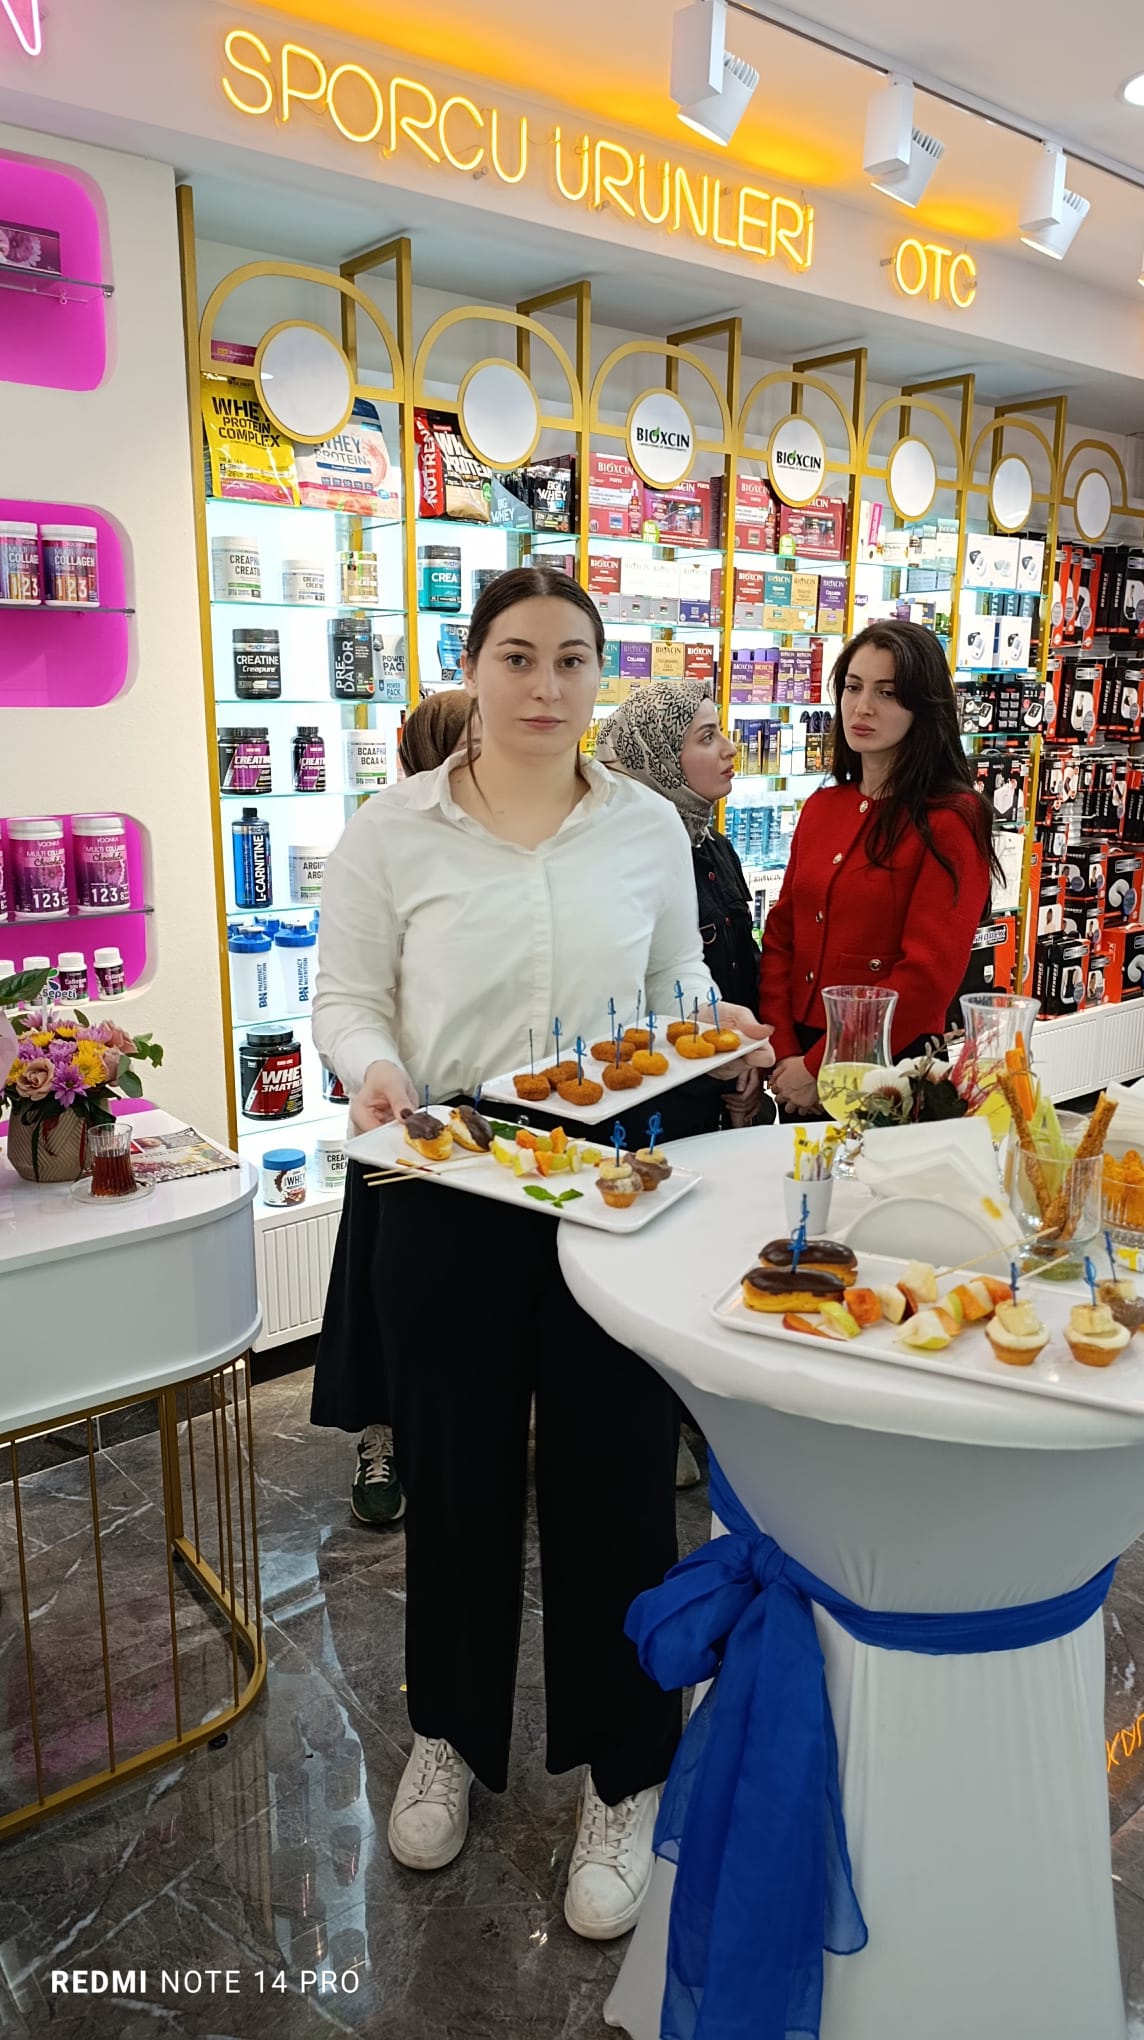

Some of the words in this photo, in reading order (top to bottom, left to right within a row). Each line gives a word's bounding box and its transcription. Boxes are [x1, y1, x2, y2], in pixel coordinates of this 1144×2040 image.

[222, 29, 528, 184] SPORCU
[895, 237, 976, 308] OTC
[223, 416, 271, 434] PROTEIN
[218, 426, 281, 448] COMPLEX
[636, 426, 690, 448] BIOXCIN
[776, 449, 822, 470] BIOXCIN
[537, 487, 568, 502] WHEY
[490, 508, 516, 523] WHEY
[54, 555, 95, 567] COLLAGEN
[236, 655, 279, 665] CREATINE
[254, 835, 267, 902] L-CARNITINE
